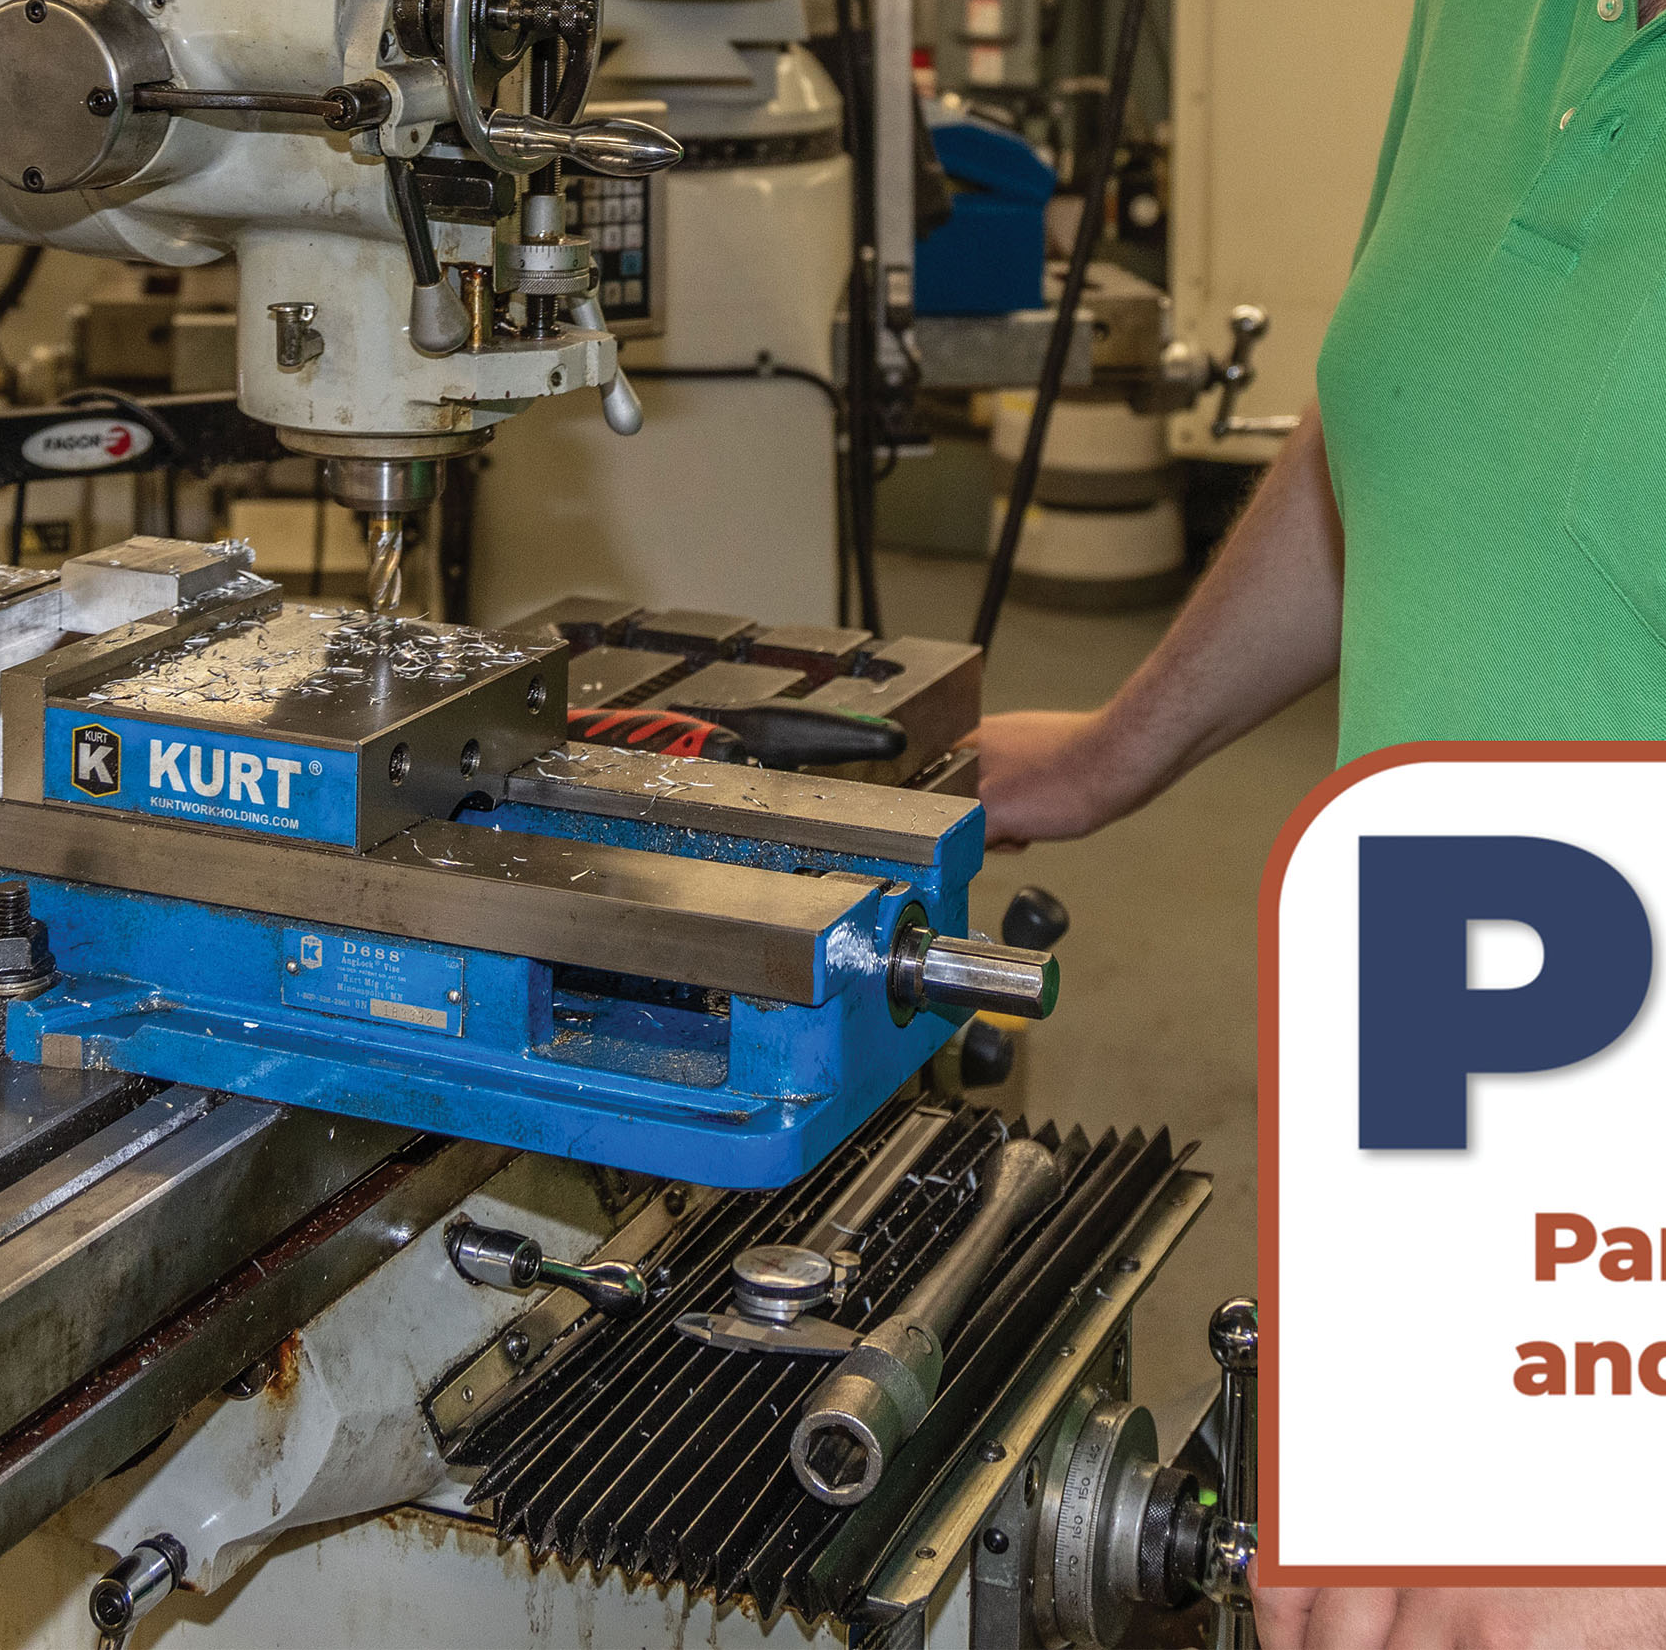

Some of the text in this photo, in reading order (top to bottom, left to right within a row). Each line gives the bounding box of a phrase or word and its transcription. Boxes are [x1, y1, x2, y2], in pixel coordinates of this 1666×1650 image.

[84, 729, 109, 744] KURT
[77, 742, 115, 786] K
[149, 795, 300, 831] KURTWORKHOLDING.COM
[342, 973, 362, 985] Kurt
[383, 963, 400, 974] Vise
[389, 991, 404, 1002] MN
[1078, 1476, 1091, 1501] 150
[1072, 1514, 1084, 1540] 160
[1068, 1554, 1079, 1578] 170
